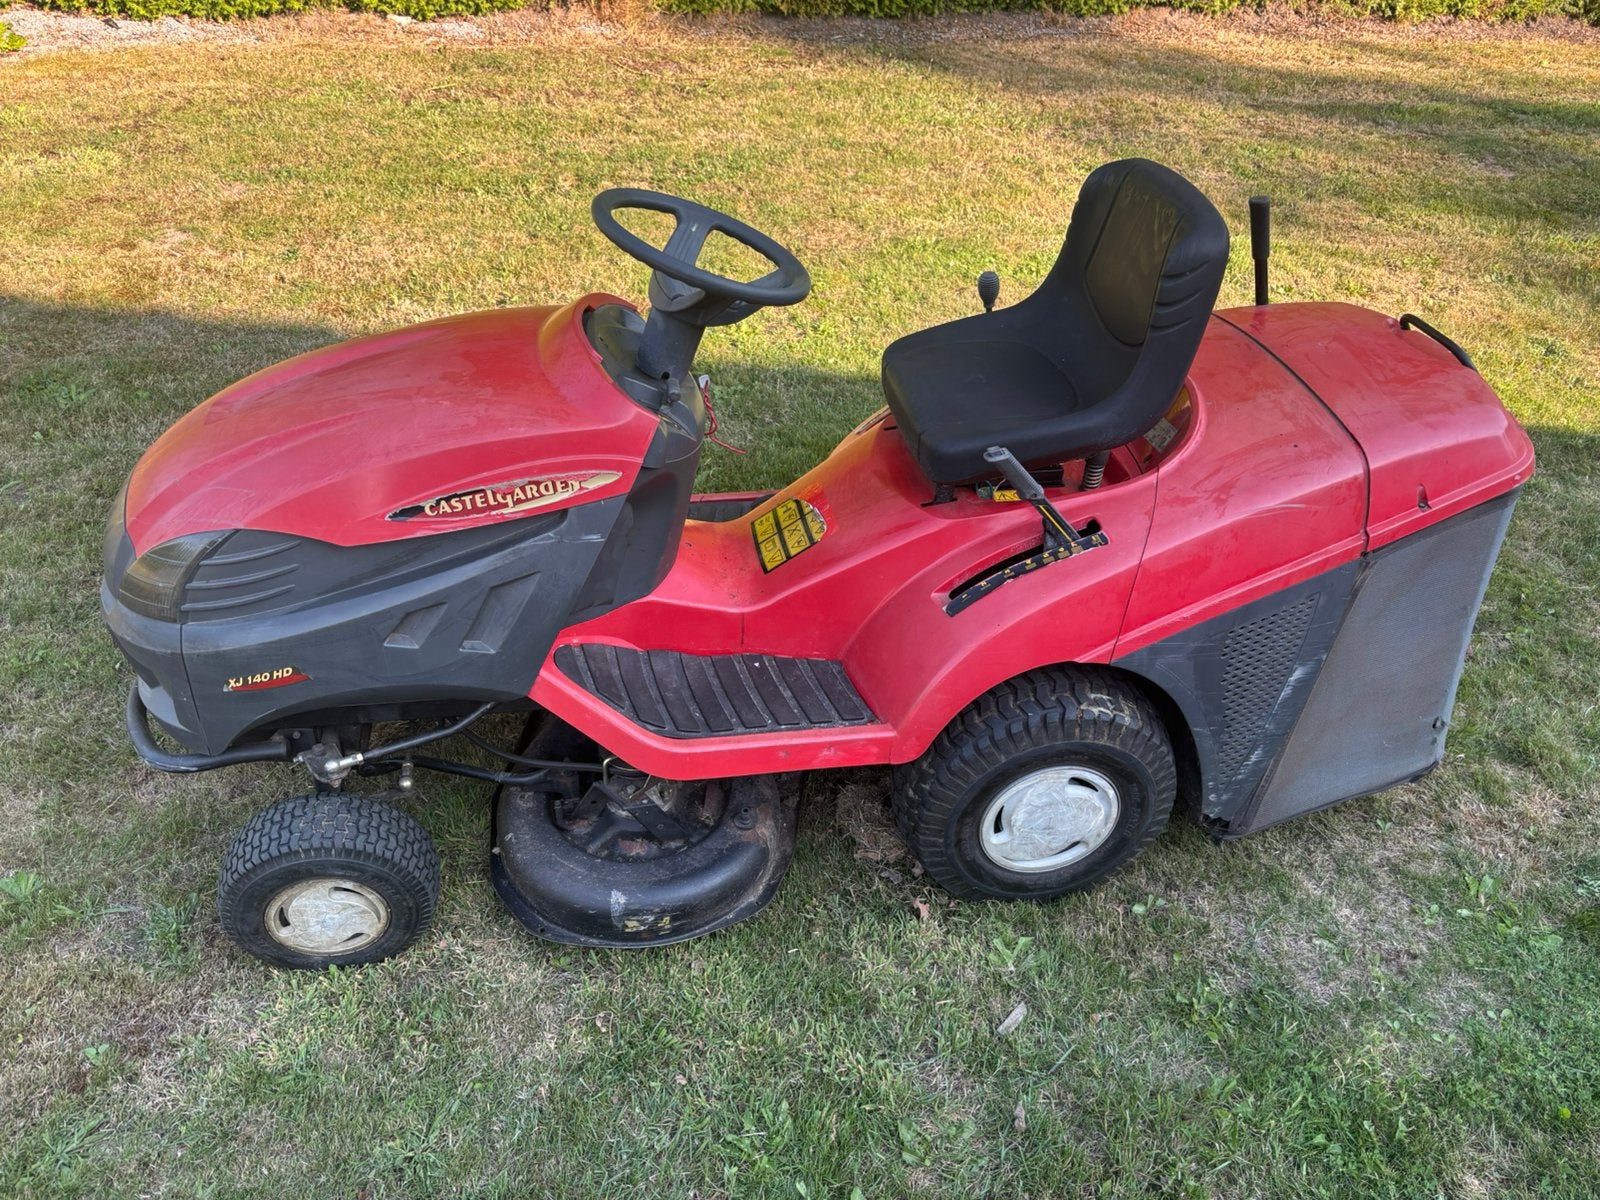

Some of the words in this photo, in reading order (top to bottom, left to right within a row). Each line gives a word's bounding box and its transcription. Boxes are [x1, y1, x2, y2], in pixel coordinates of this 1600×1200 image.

[228, 677, 243, 688] XJ
[247, 673, 270, 684] 140
[273, 667, 292, 679] HD
